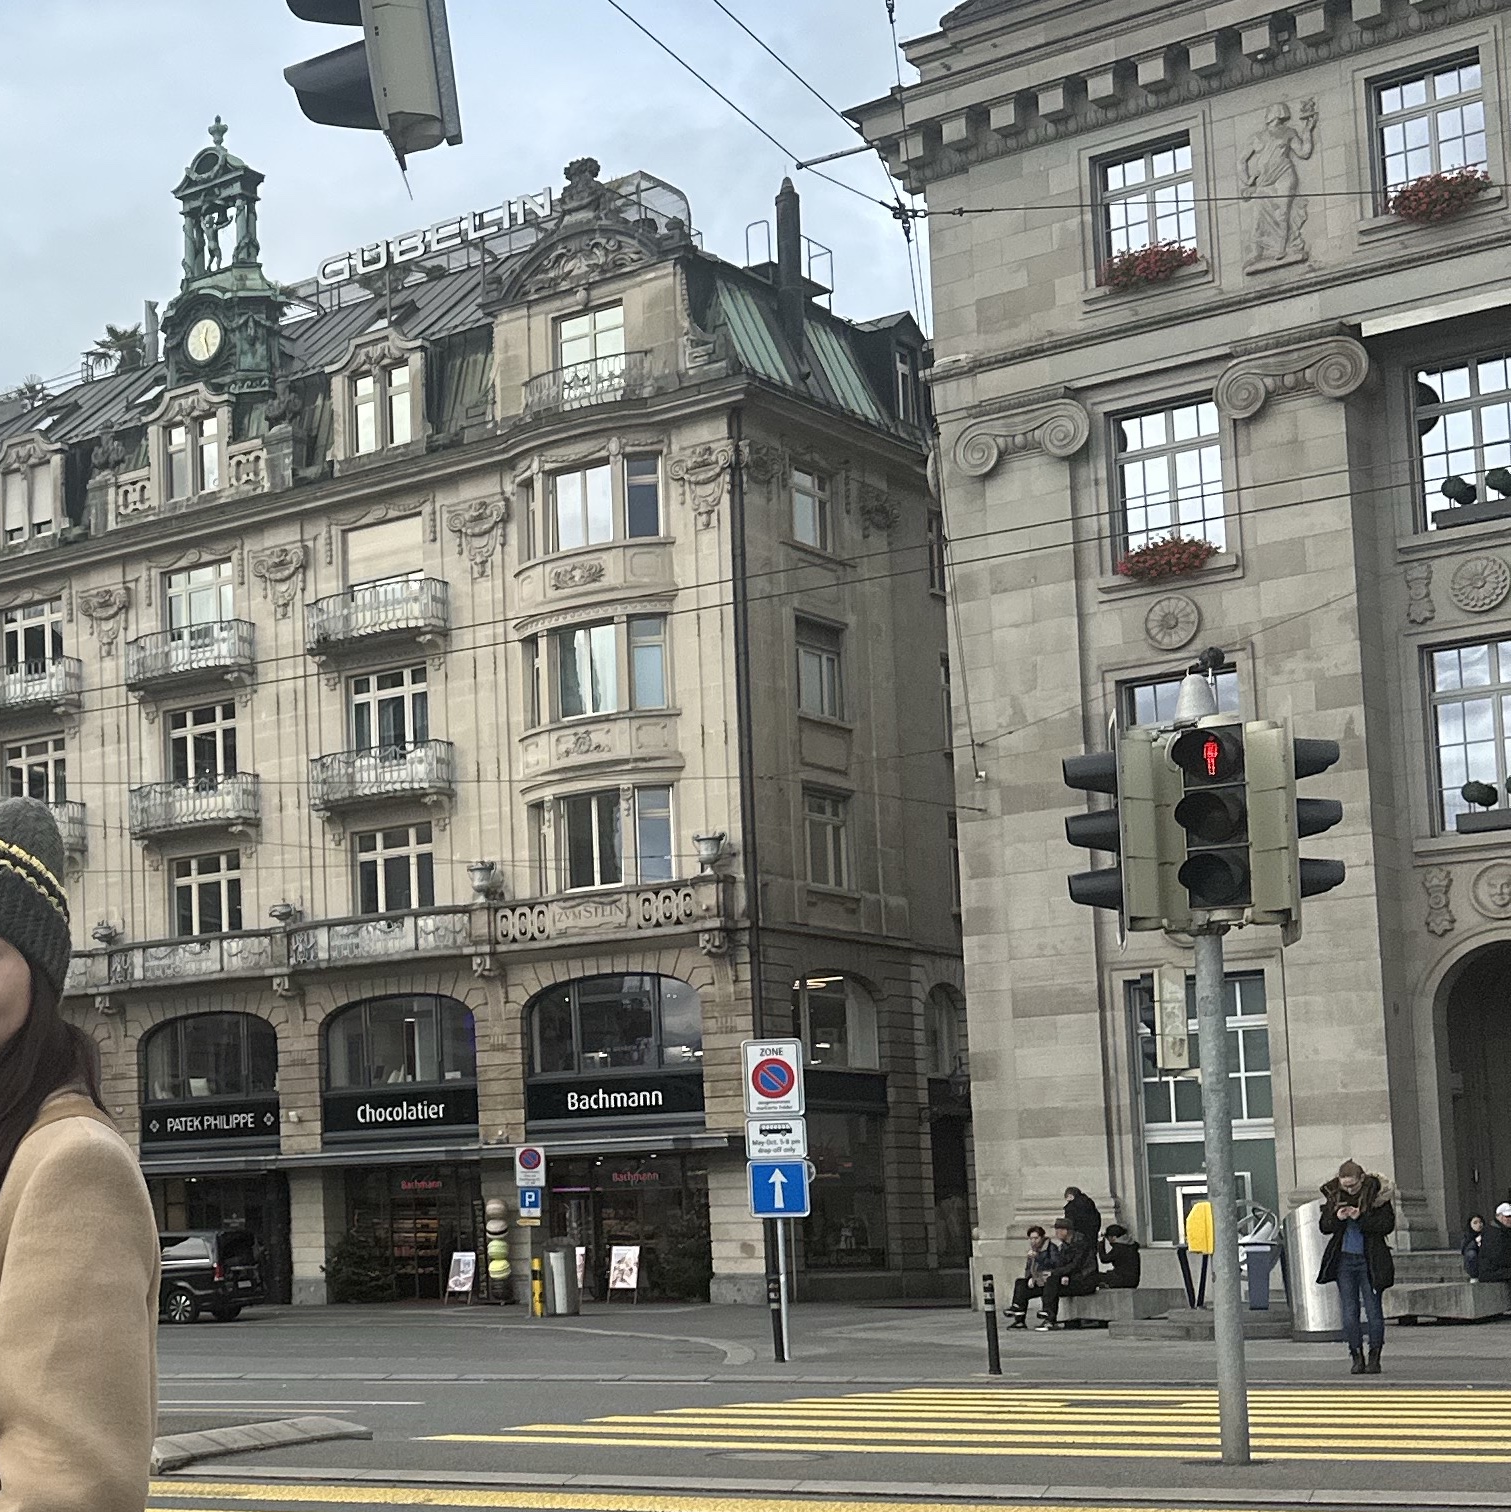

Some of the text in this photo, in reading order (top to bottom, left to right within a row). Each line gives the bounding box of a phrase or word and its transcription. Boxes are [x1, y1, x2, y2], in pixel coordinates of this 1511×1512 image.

[759, 1047, 784, 1057] ZONE
[567, 1088, 664, 1111] Bachmann
[356, 1100, 446, 1124] Chocolatier
[166, 1112, 256, 1132] PATEK PHILIPPE
[611, 1170, 659, 1183] Bachmann
[525, 1191, 536, 1208] P
